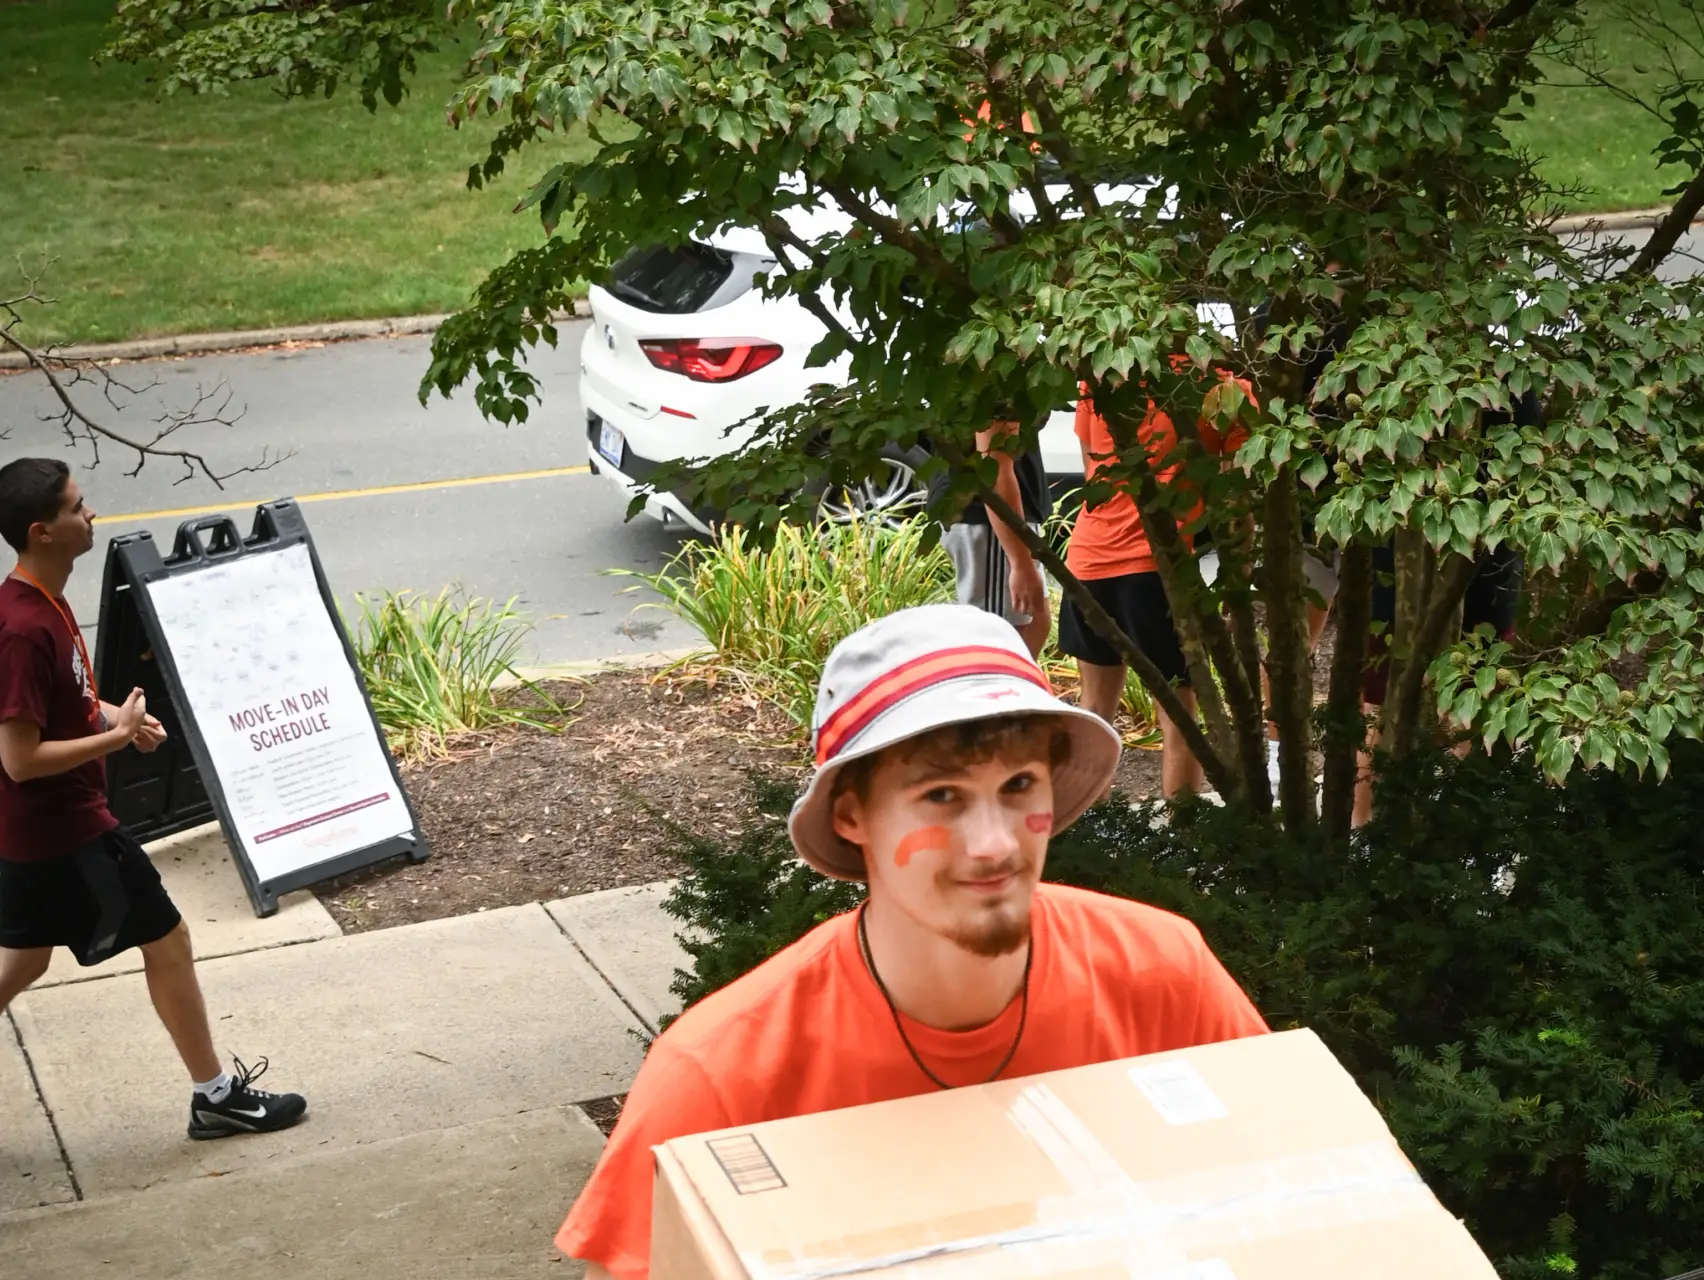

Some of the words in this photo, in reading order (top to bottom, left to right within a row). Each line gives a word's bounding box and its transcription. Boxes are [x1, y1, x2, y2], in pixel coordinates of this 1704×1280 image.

[228, 696, 300, 732] MOVE-IN
[300, 686, 330, 711] DAY
[249, 712, 331, 752] SCHEDULE
